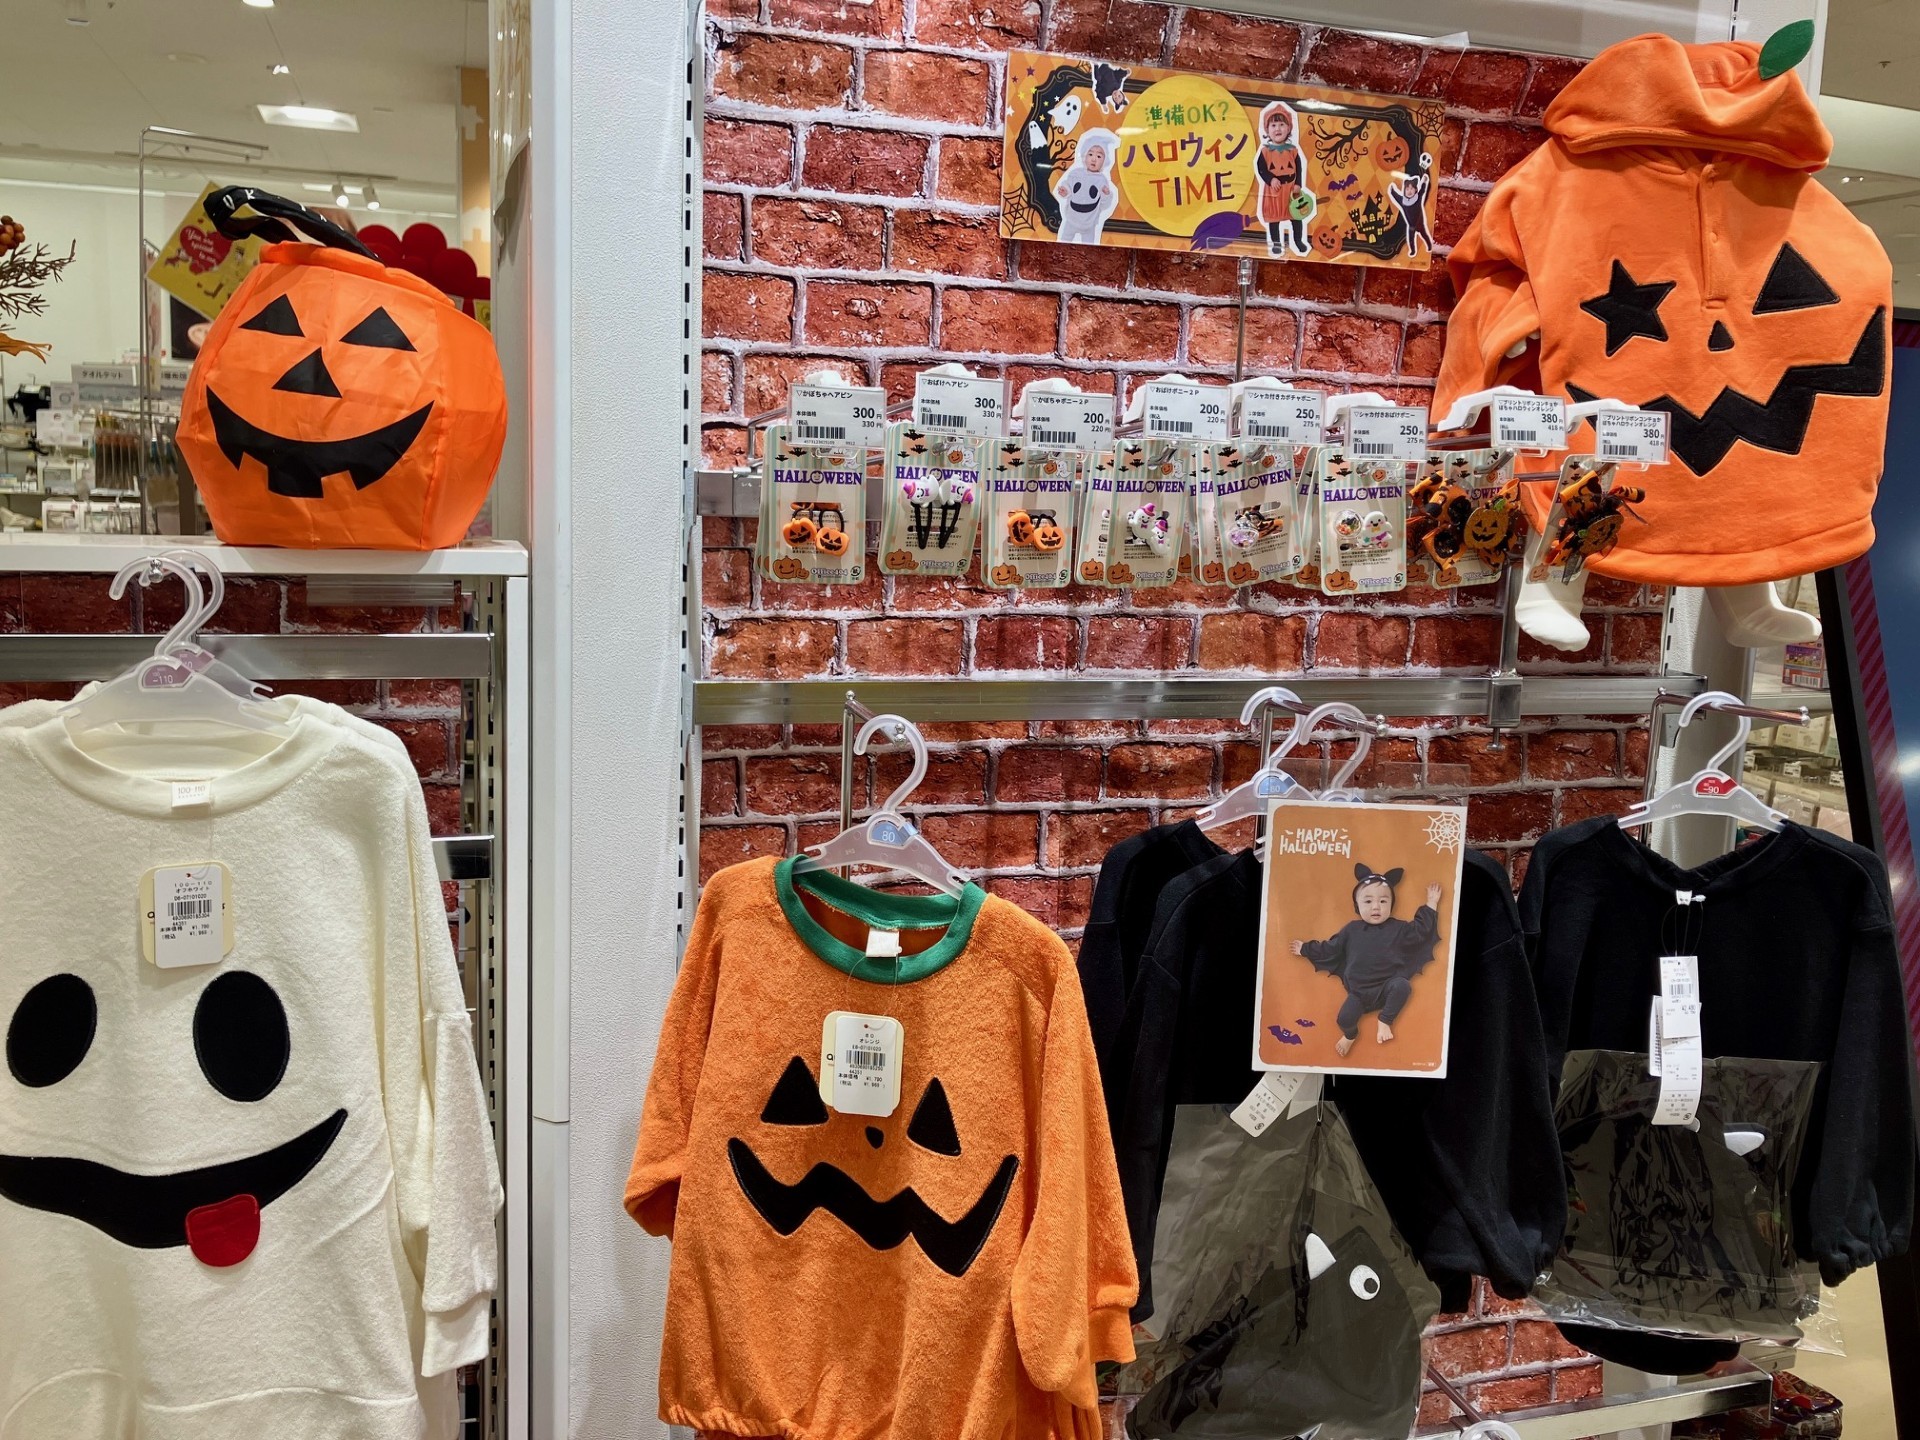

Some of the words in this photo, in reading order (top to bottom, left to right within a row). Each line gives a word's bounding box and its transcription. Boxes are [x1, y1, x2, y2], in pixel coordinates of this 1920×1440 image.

[1123, 132, 1248, 168] ハロウィン
[1149, 170, 1235, 208] TIME
[774, 469, 862, 485] HALLOWEEN
[1217, 468, 1292, 496] HALLOWEEN
[994, 480, 1072, 493] HALLOWEEN
[1116, 480, 1186, 493] HALLOWEEN
[1323, 486, 1402, 502] HALLOWEEN
[881, 830, 896, 842] 80
[1297, 828, 1339, 842] HAPPY
[1279, 835, 1352, 859] HALLOWEEN
